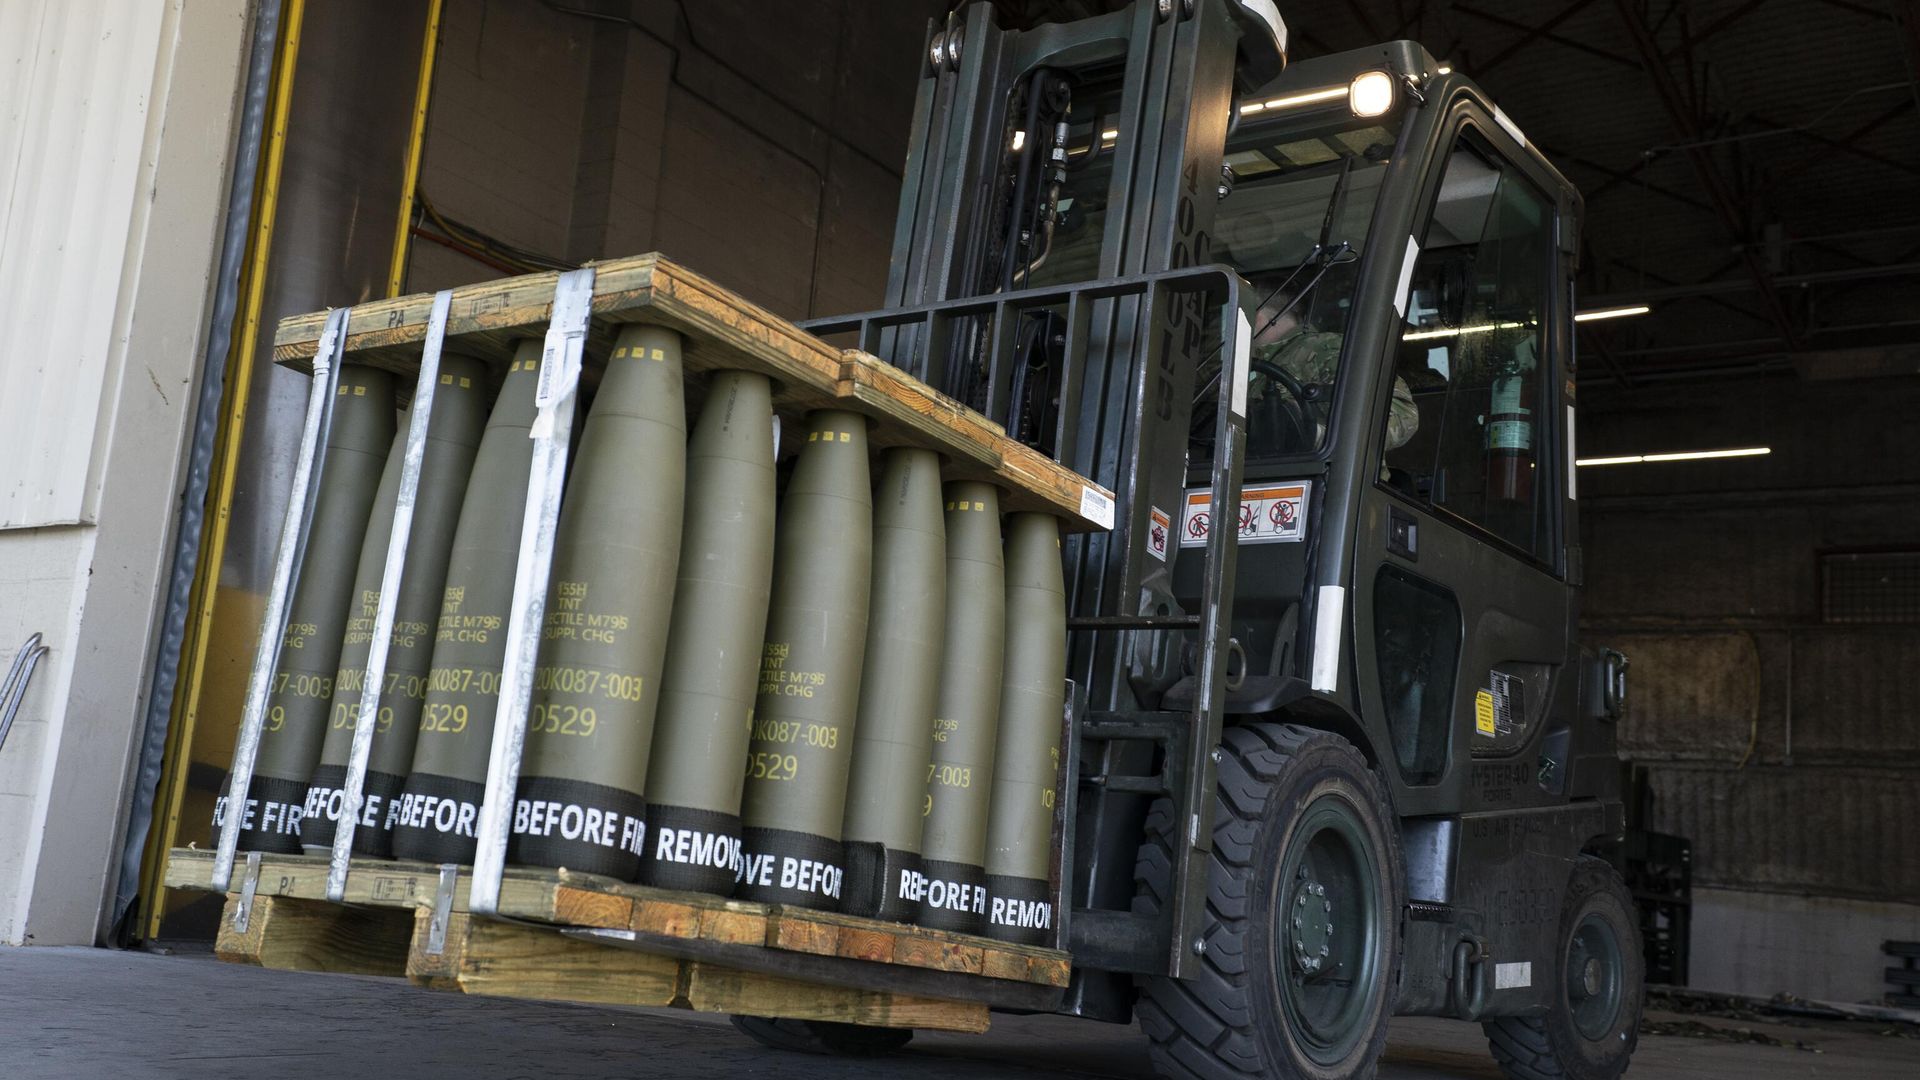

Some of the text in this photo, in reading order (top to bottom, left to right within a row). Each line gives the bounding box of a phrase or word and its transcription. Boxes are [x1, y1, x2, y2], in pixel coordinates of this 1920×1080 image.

[558, 598, 582, 610] TNT
[588, 614, 629, 630] M795
[458, 630, 487, 643] CHG
[582, 628, 615, 644] CHG
[784, 684, 813, 698] CHG
[333, 703, 394, 733] D59
[531, 704, 597, 737] D529
[303, 787, 381, 828] BEFOE
[513, 799, 618, 848] BEFORE
